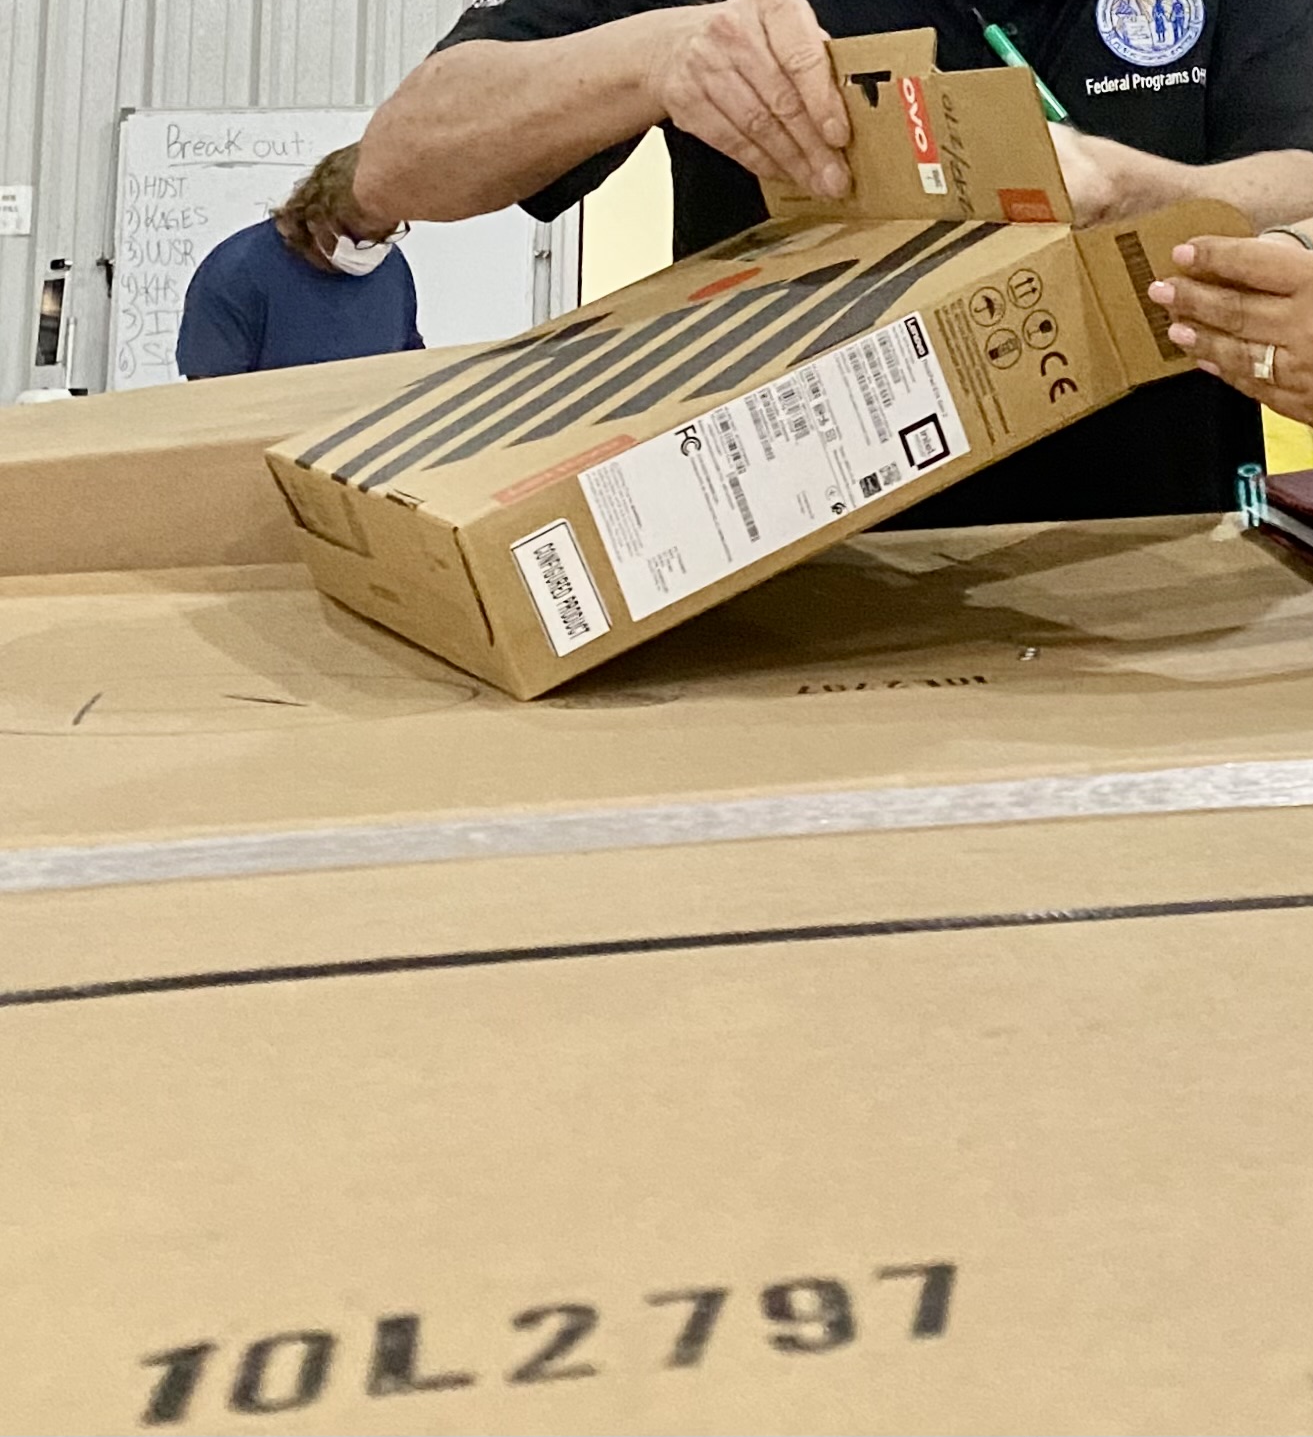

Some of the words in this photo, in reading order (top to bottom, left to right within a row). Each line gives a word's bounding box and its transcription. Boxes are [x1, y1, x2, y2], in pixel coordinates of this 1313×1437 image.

[1085, 73, 1130, 96] Federal
[1131, 69, 1189, 92] Programs
[166, 124, 243, 159] Break
[905, 317, 928, 357] Lenovo
[533, 542, 573, 599] CONFIGURED
[556, 595, 590, 640] PRODUCT
[139, 1259, 959, 1427] 10L2797
